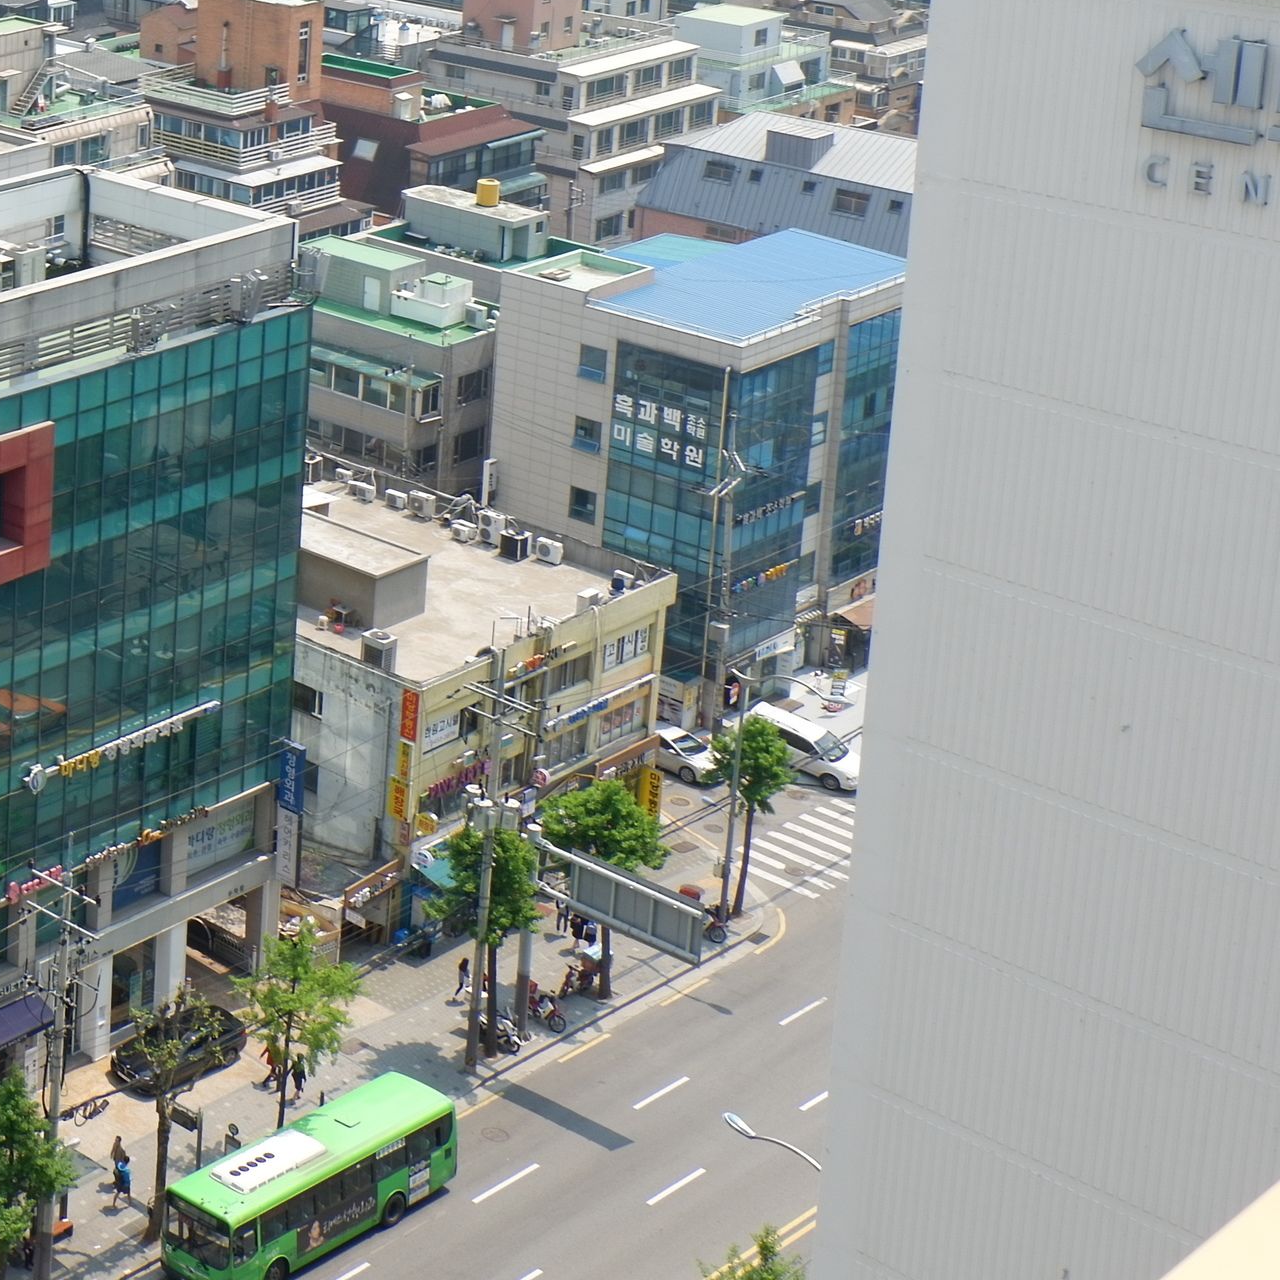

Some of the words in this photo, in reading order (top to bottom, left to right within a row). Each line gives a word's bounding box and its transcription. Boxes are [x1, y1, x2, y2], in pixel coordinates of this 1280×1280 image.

[1135, 27, 1280, 146] 센
[615, 393, 682, 432] 흑과백
[686, 422, 705, 440] 학원
[613, 423, 703, 468] 미술학원
